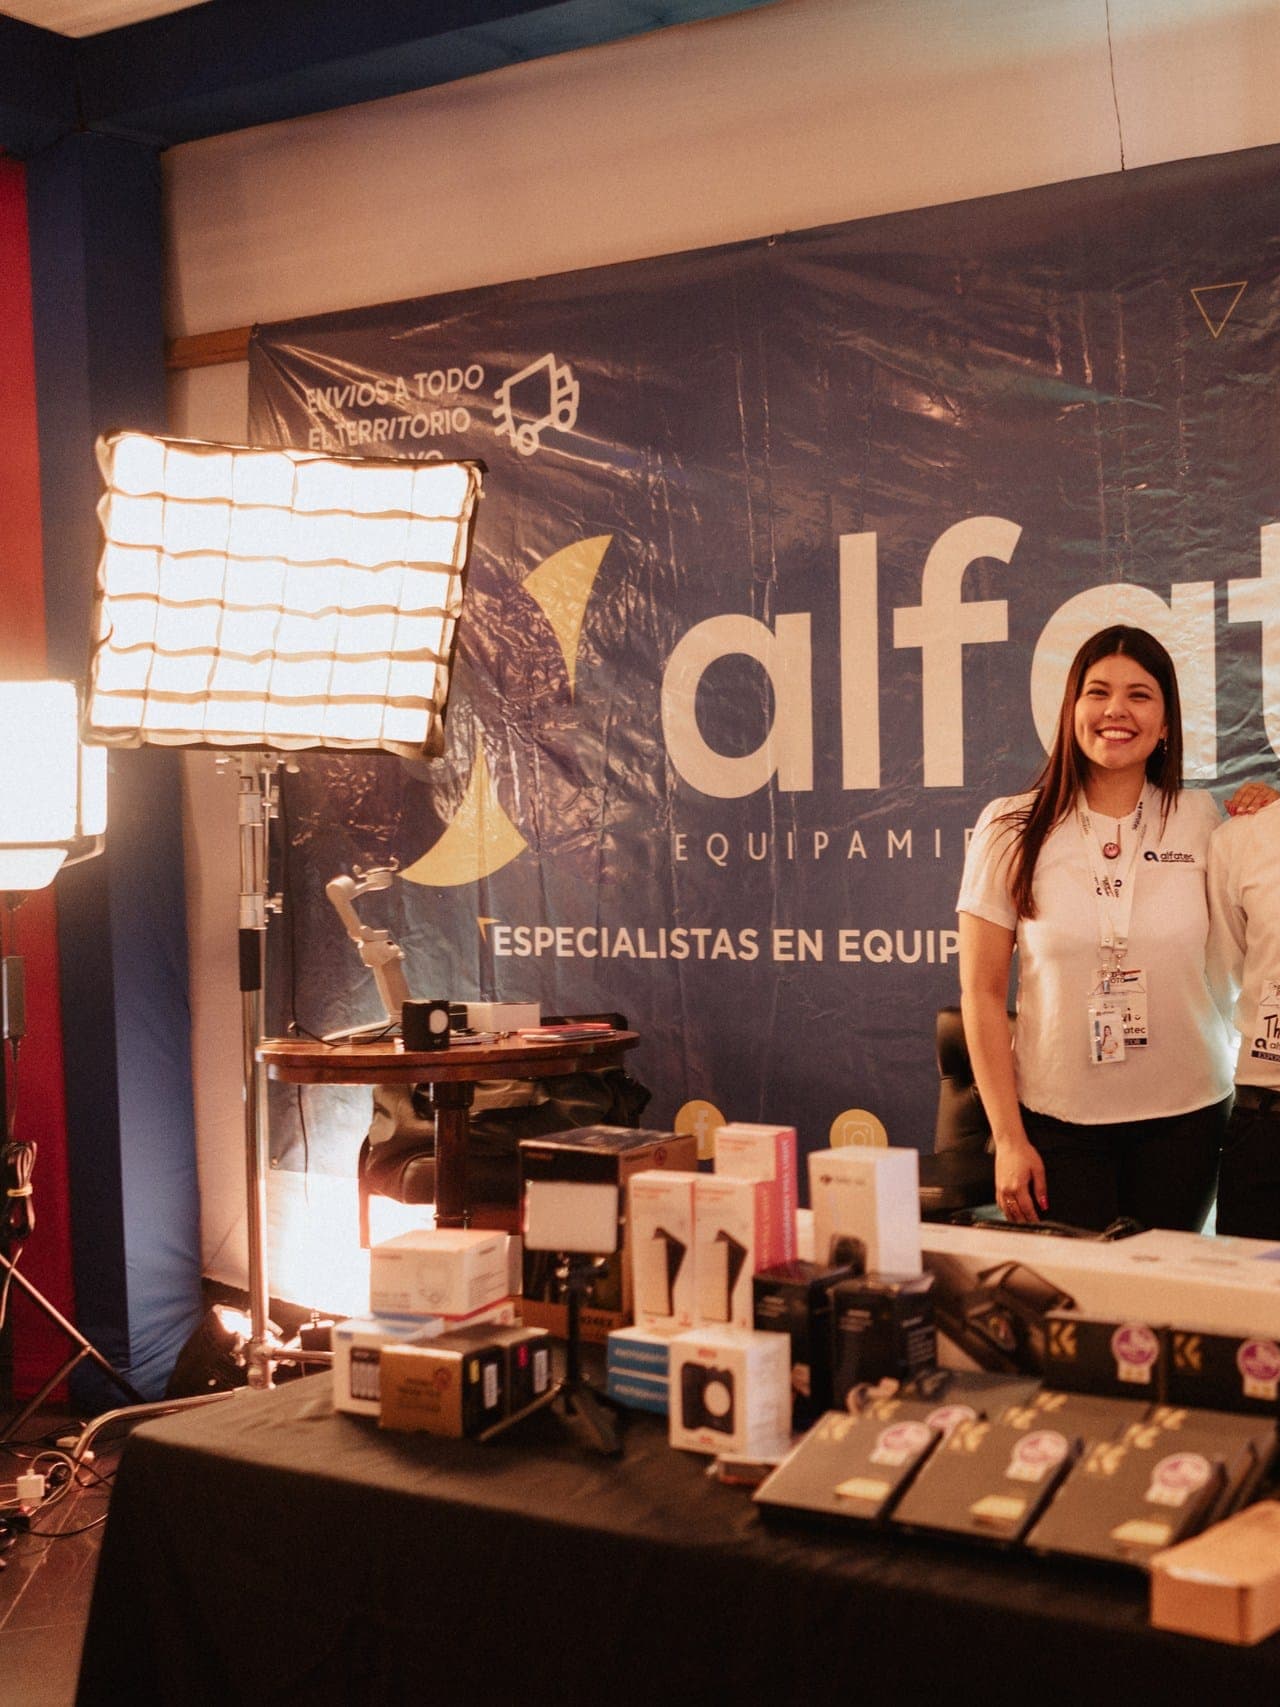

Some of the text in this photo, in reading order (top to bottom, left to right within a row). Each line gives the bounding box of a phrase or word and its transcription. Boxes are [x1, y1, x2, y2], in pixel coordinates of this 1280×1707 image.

[305, 365, 484, 415] ENVIOS A TODO
[335, 407, 472, 447] TERRITORIO
[1160, 850, 1193, 861] alfatec
[494, 925, 760, 961] ESPECIALISTAS
[772, 929, 824, 963] EN
